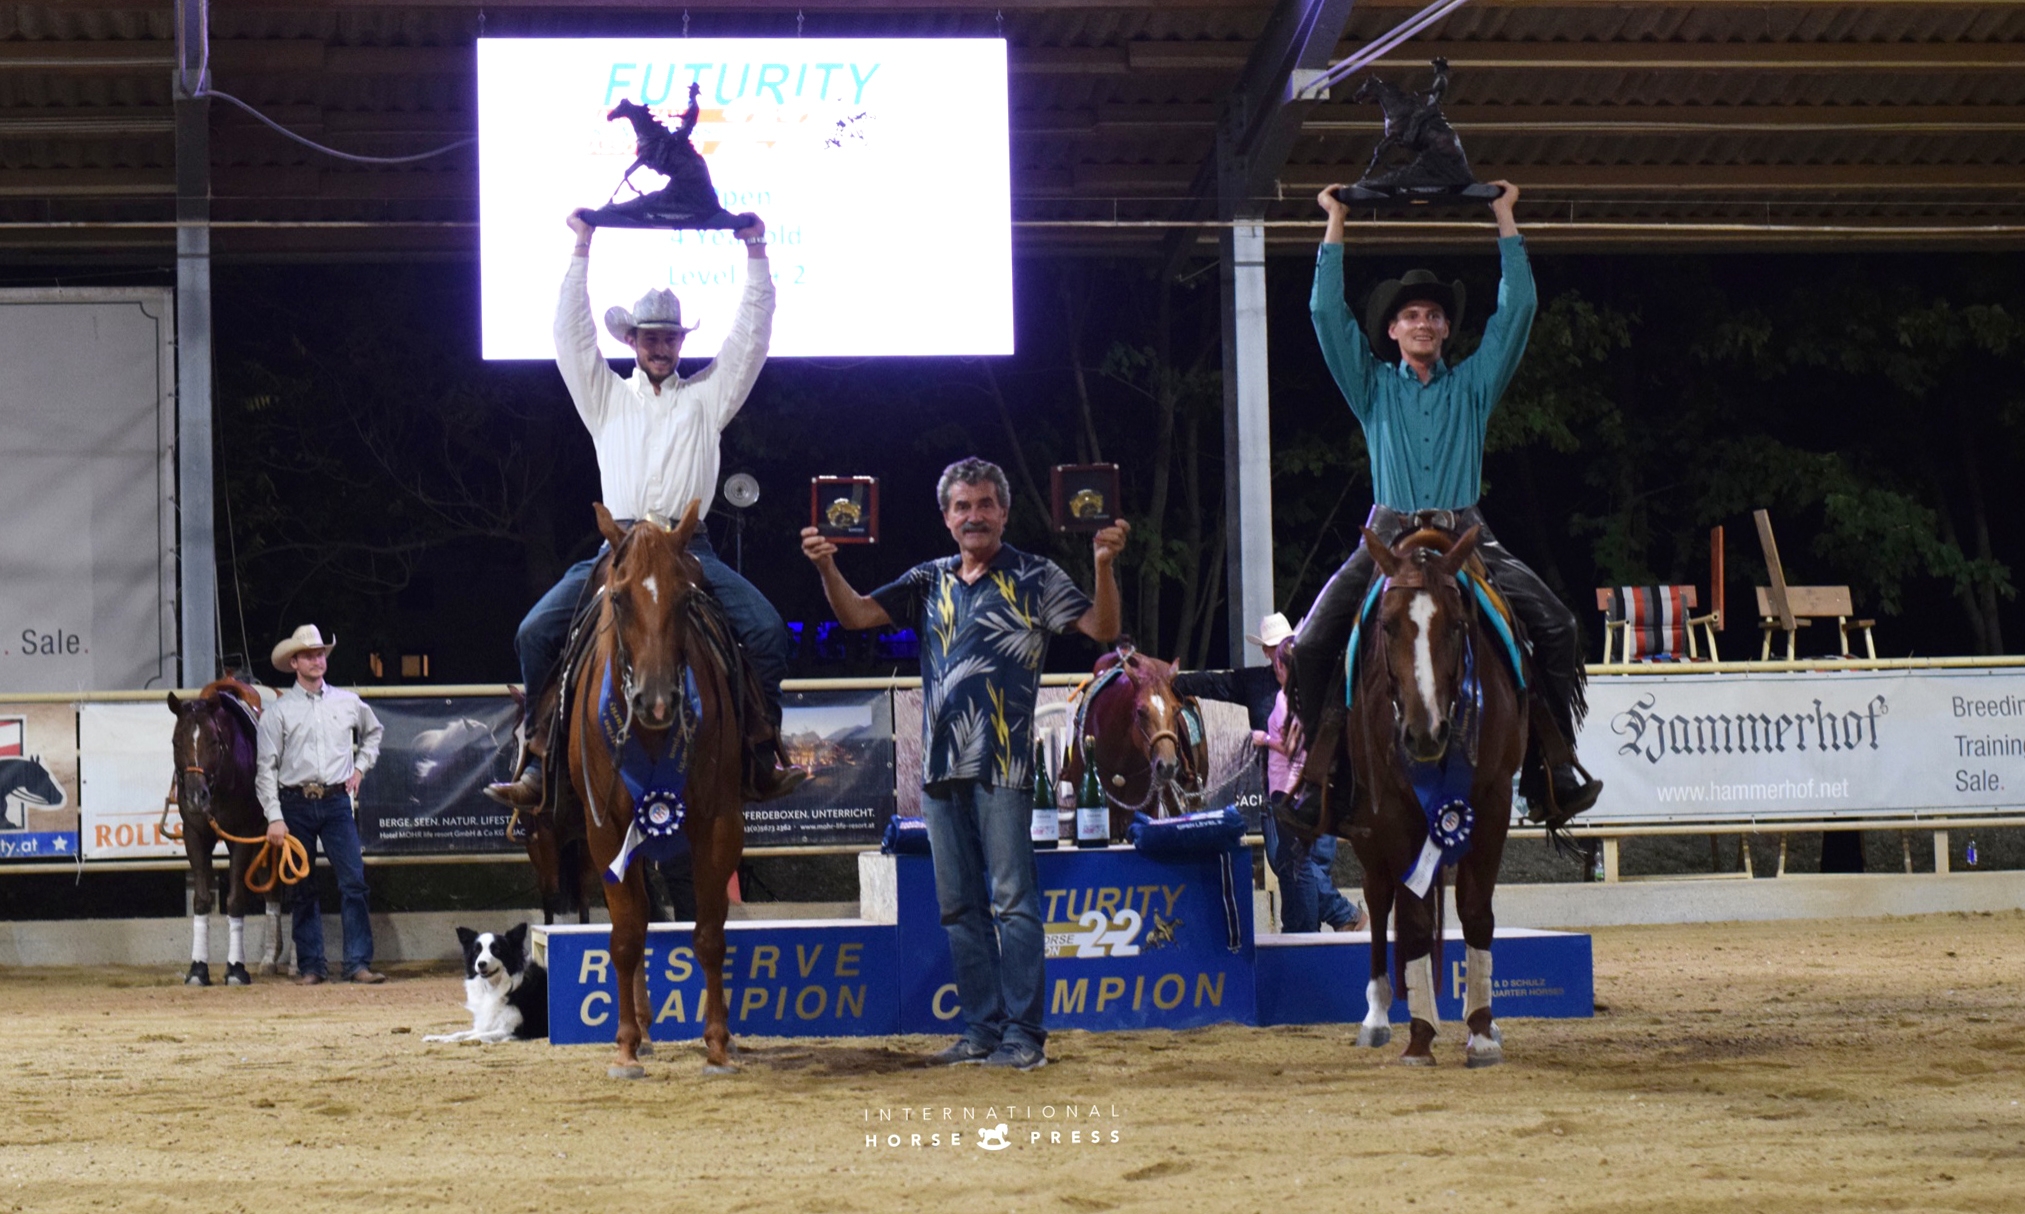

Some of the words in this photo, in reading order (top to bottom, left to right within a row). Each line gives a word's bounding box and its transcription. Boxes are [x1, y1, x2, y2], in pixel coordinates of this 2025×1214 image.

[603, 62, 881, 106] FUTURITY
[714, 187, 771, 209] pen
[765, 224, 802, 246] old
[669, 265, 735, 286] Level
[793, 264, 806, 285] 2
[22, 629, 89, 655] Sale.
[1611, 692, 1888, 764] Hammerhof
[1954, 734, 2025, 757] Trainin
[1657, 778, 1849, 802] www.hammerhof.net
[1956, 769, 2004, 792] Sale.
[379, 818, 412, 828] BERGE.
[414, 817, 440, 827] SEEN.
[442, 816, 478, 827] NATUR.
[742, 810, 809, 820] FERDEBOXEN.
[811, 808, 875, 819] UNTERRICHT.
[379, 831, 398, 839] Hotel
[399, 831, 422, 839] MOHR
[454, 829, 475, 837] GmbH
[1044, 884, 1186, 922] TURITY
[1076, 908, 1142, 958] 22
[578, 943, 864, 984] RSRVE
[1492, 988, 1527, 998] UARTER
[1511, 978, 1546, 987] SCHULZ
[580, 984, 867, 1026] CAPION
[932, 972, 1226, 1020] CMPION
